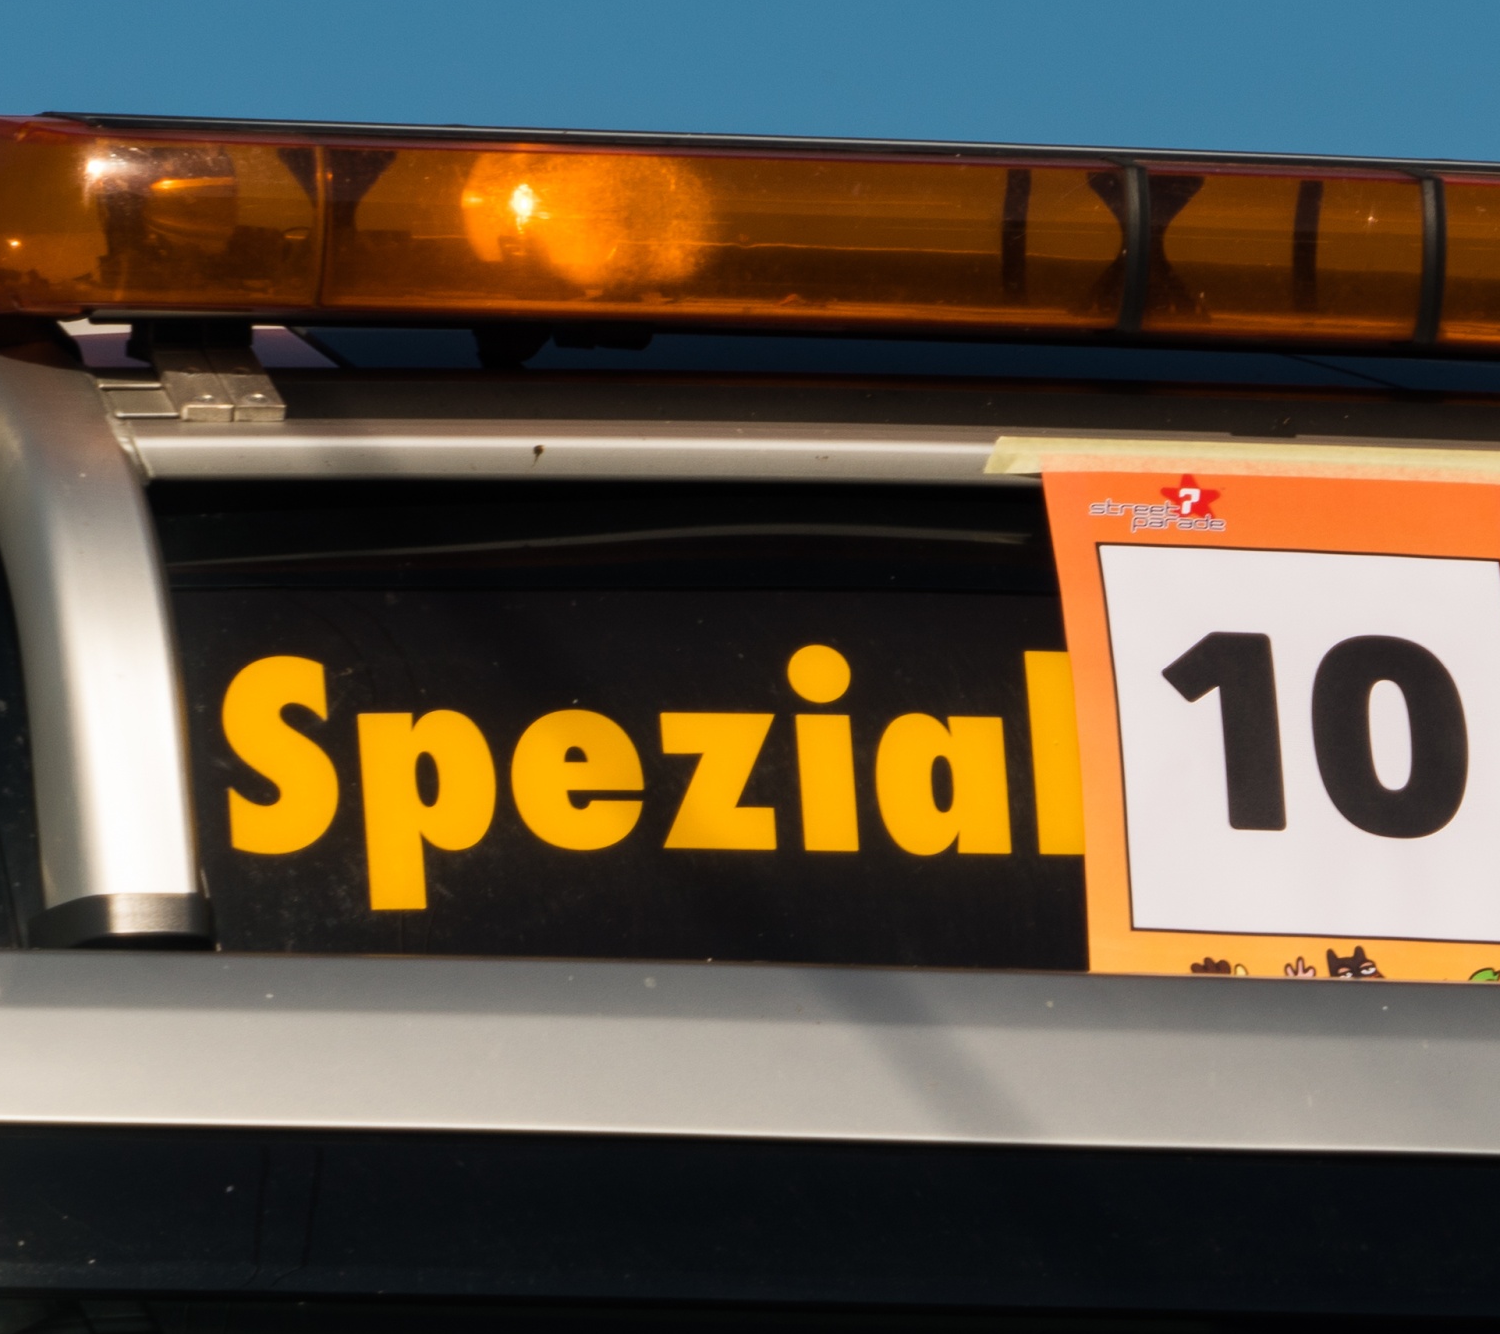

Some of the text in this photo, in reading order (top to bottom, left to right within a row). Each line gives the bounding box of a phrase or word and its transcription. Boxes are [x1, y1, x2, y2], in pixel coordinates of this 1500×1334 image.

[1089, 498, 1180, 517] street
[1131, 513, 1227, 533] parade
[1161, 630, 1469, 840] 10
